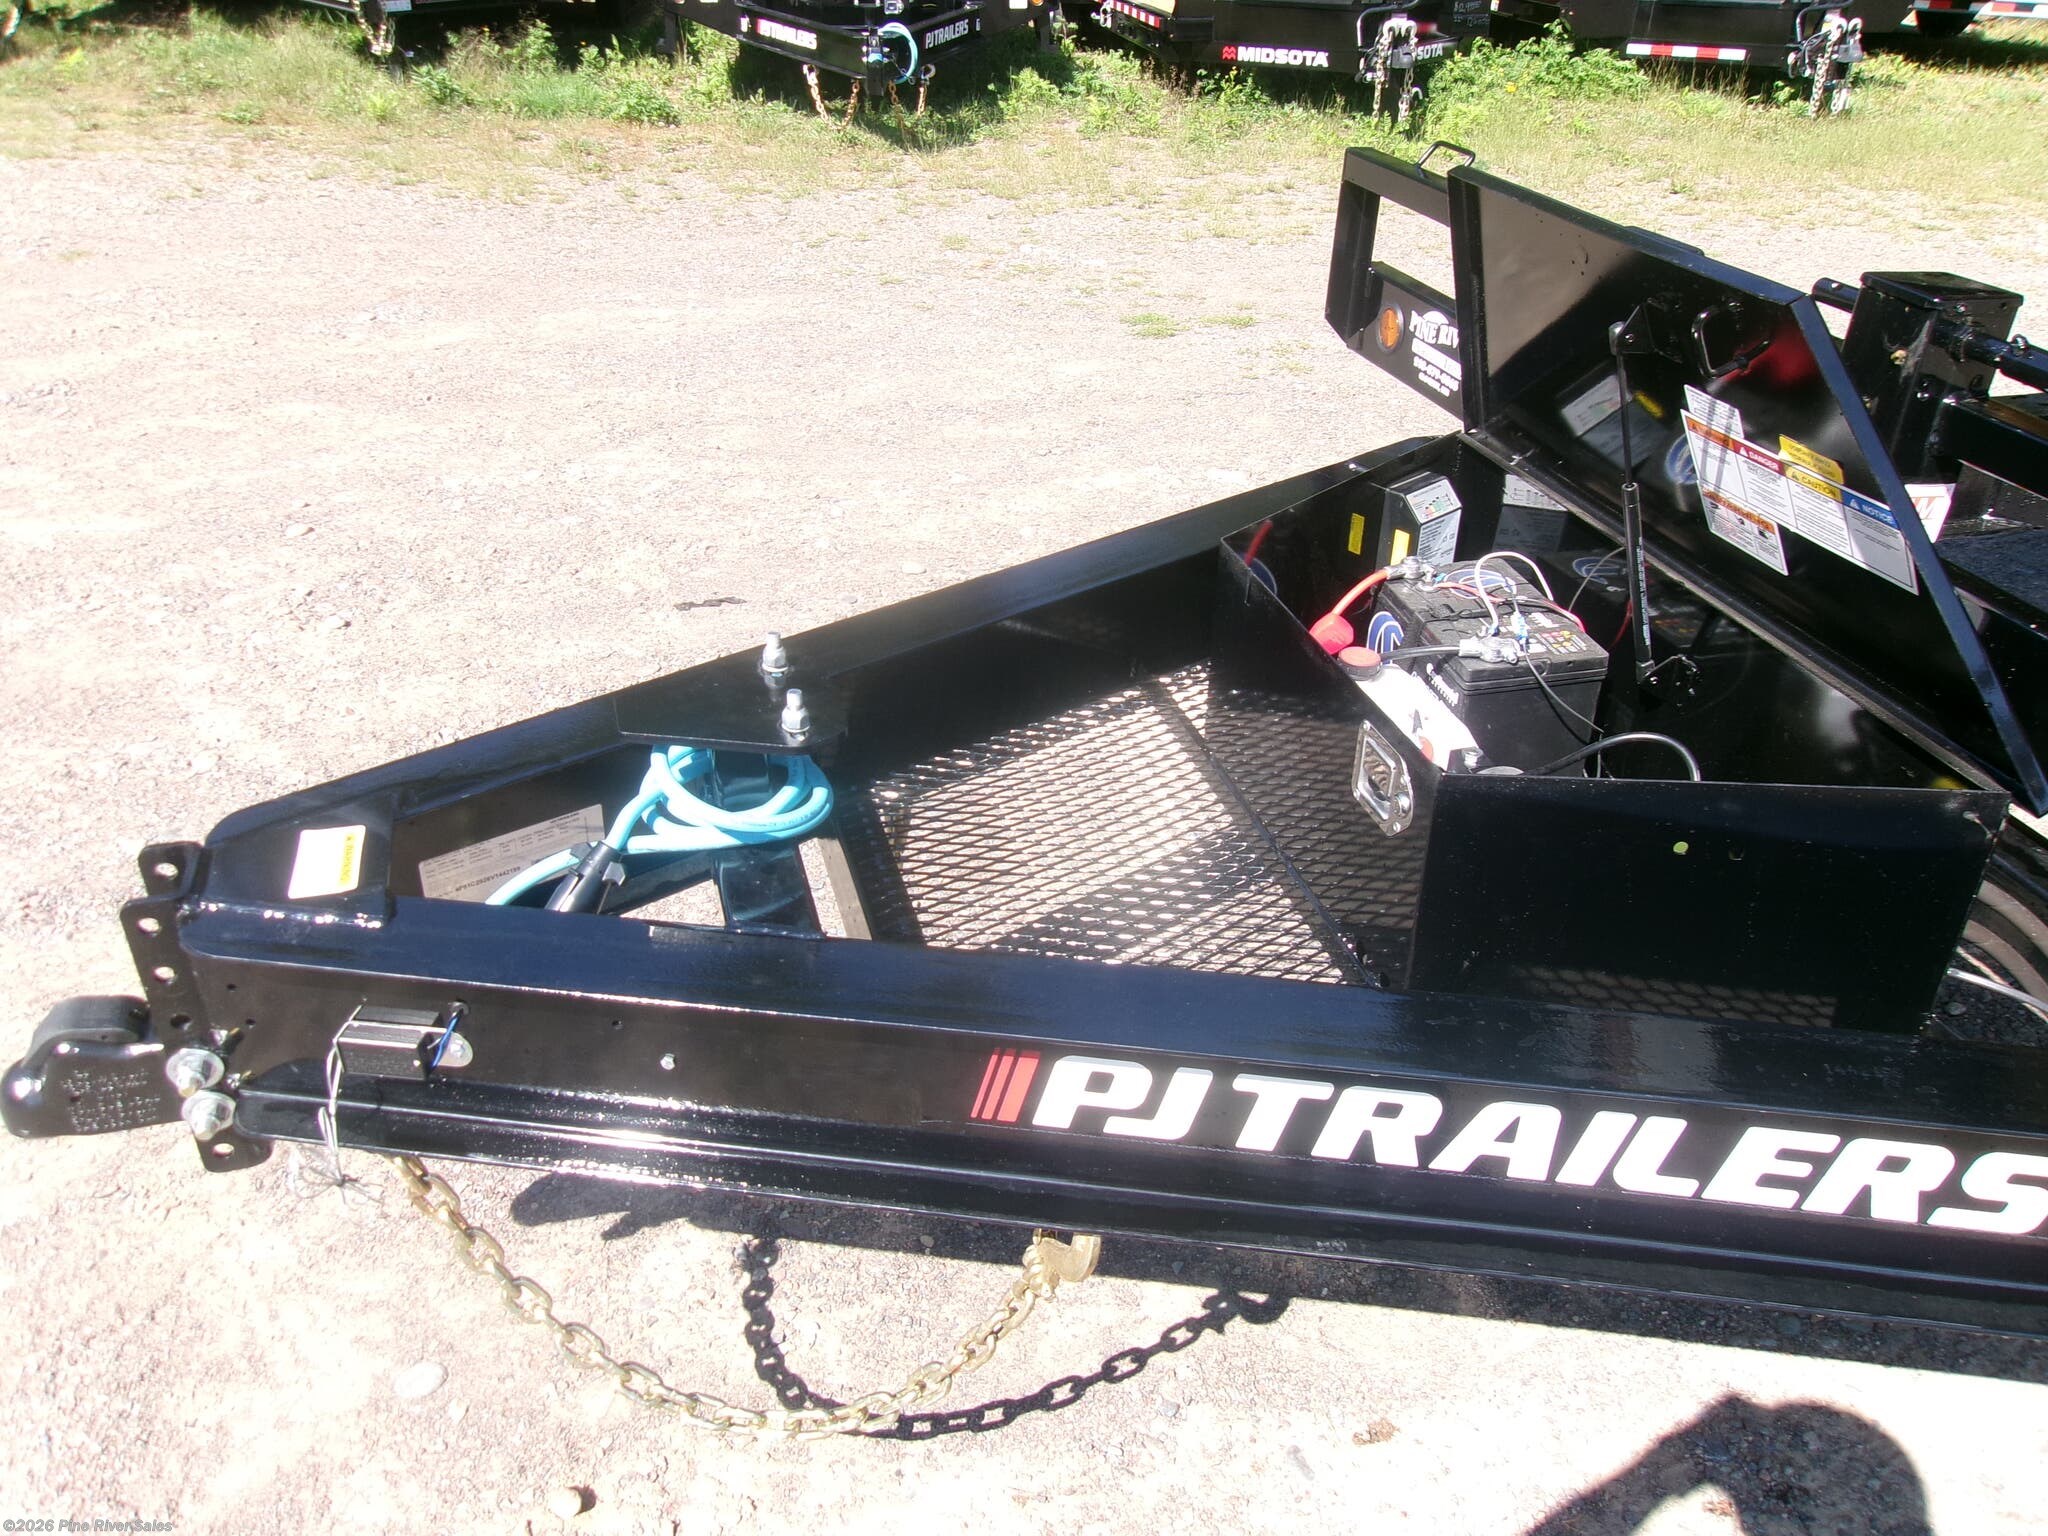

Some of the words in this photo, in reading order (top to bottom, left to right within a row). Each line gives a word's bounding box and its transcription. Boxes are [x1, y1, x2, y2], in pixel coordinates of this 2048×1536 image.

[1237, 46, 1329, 68] MIDSOTA
[1416, 43, 1443, 60] SOTA
[1437, 324, 1459, 349] RIV
[1801, 479, 1837, 499] CAUTION
[1862, 504, 1897, 527] NOTICE
[1031, 1055, 1214, 1141] PJ
[1232, 1072, 2048, 1237] TRAILERS
